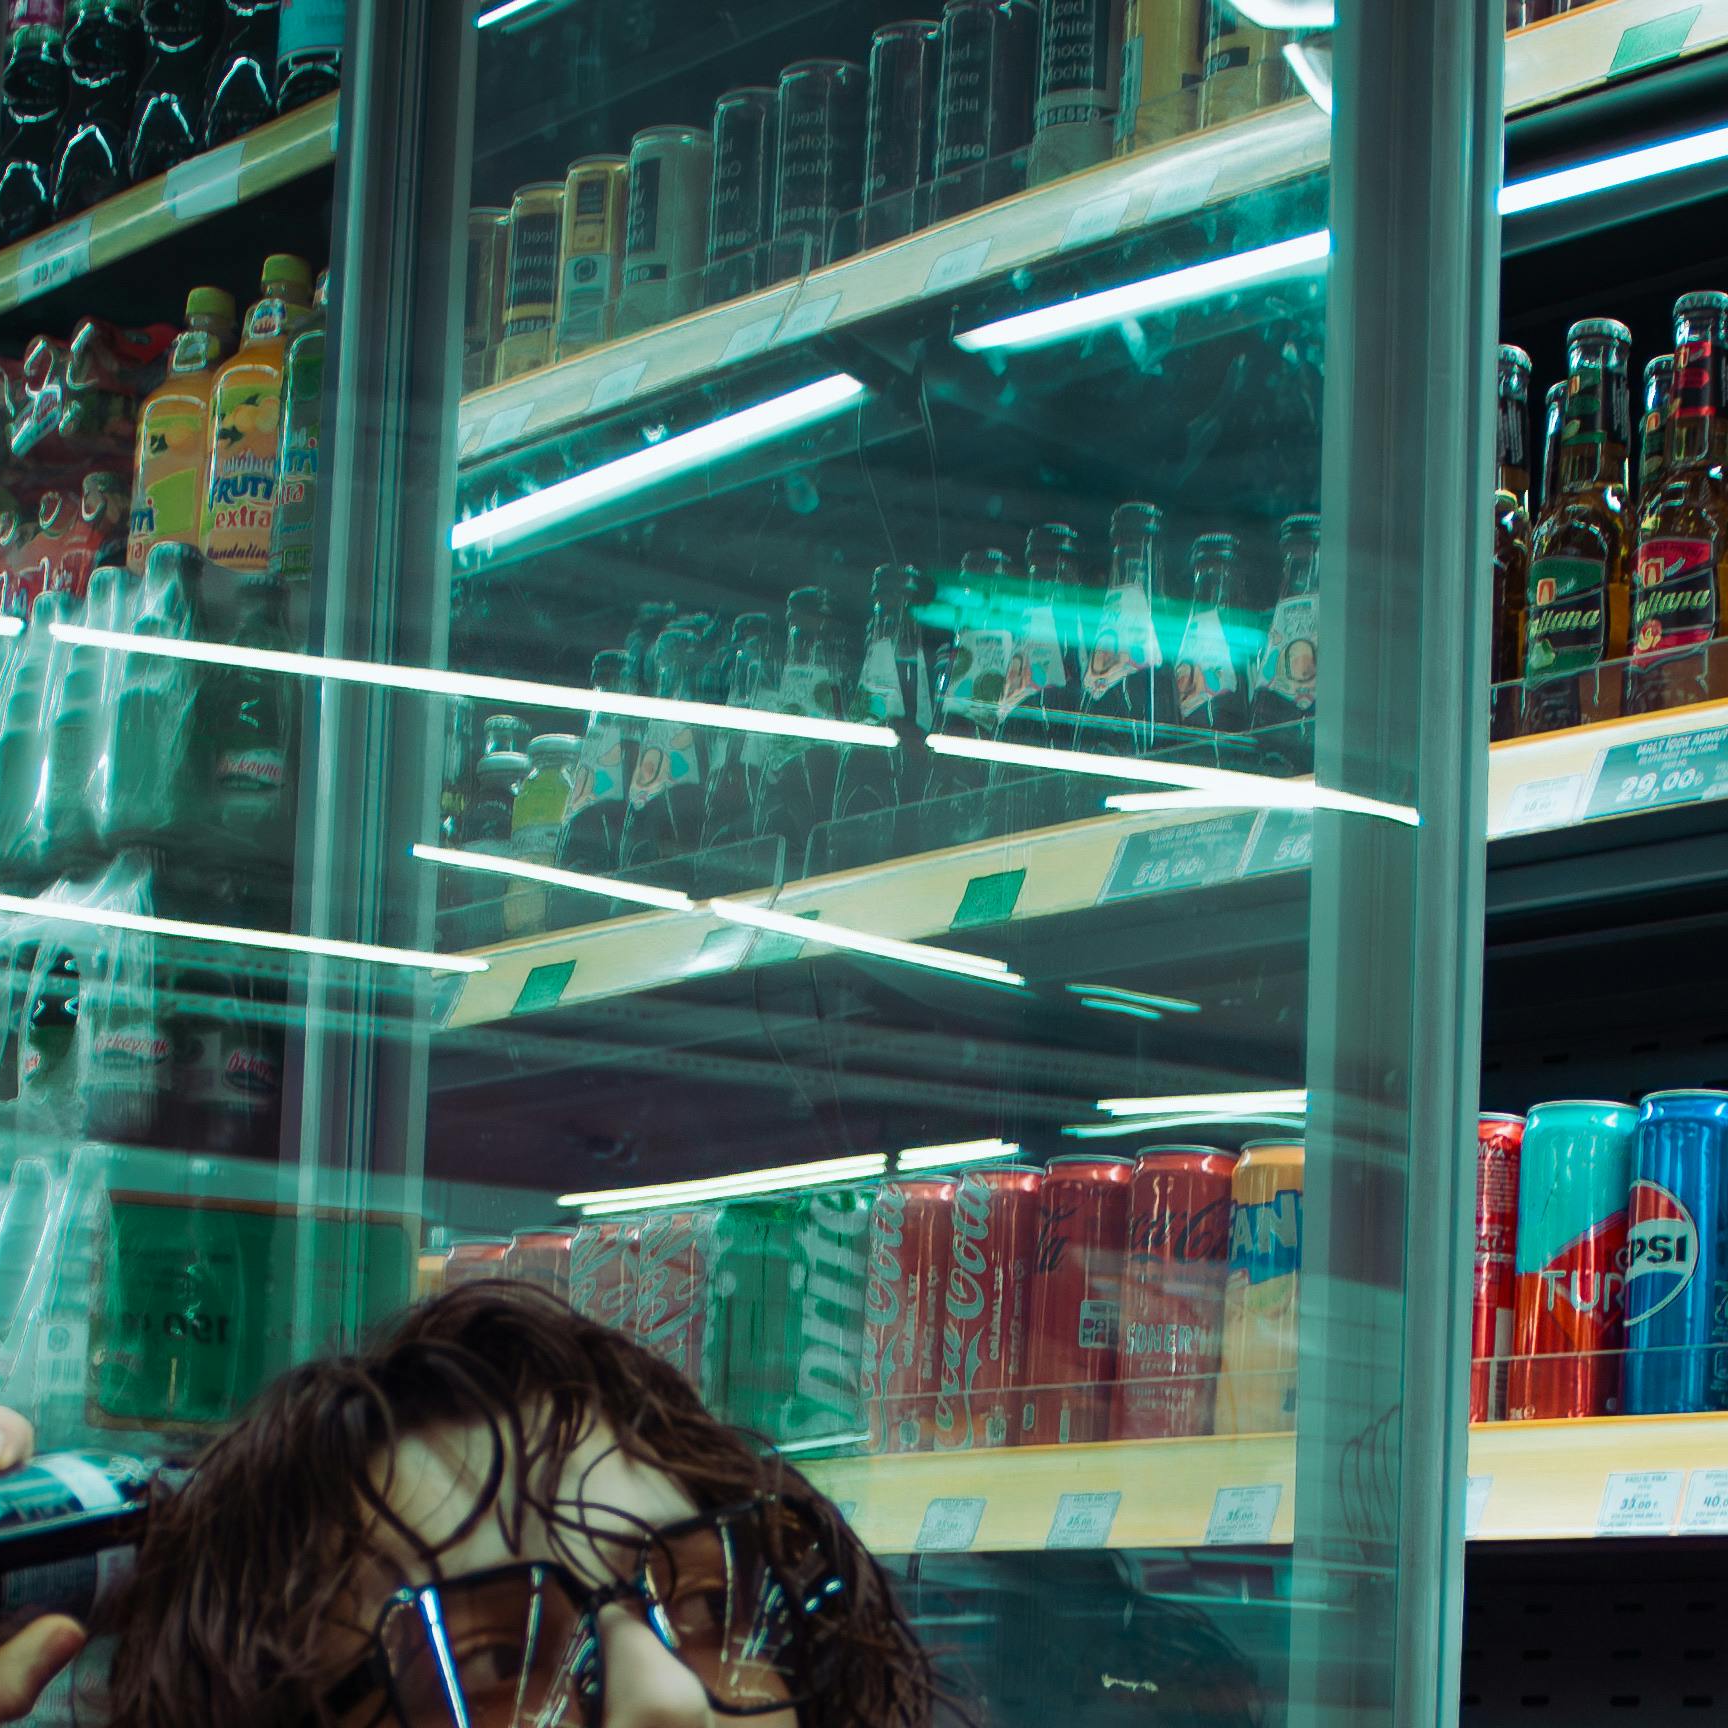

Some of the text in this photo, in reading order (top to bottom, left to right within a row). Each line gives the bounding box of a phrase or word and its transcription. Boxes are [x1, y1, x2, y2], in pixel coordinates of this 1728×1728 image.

[215, 504, 272, 530] extra
[1635, 588, 1711, 622] altana
[1629, 1234, 1689, 1268] PSI
[1540, 1270, 1626, 1313] TUR
